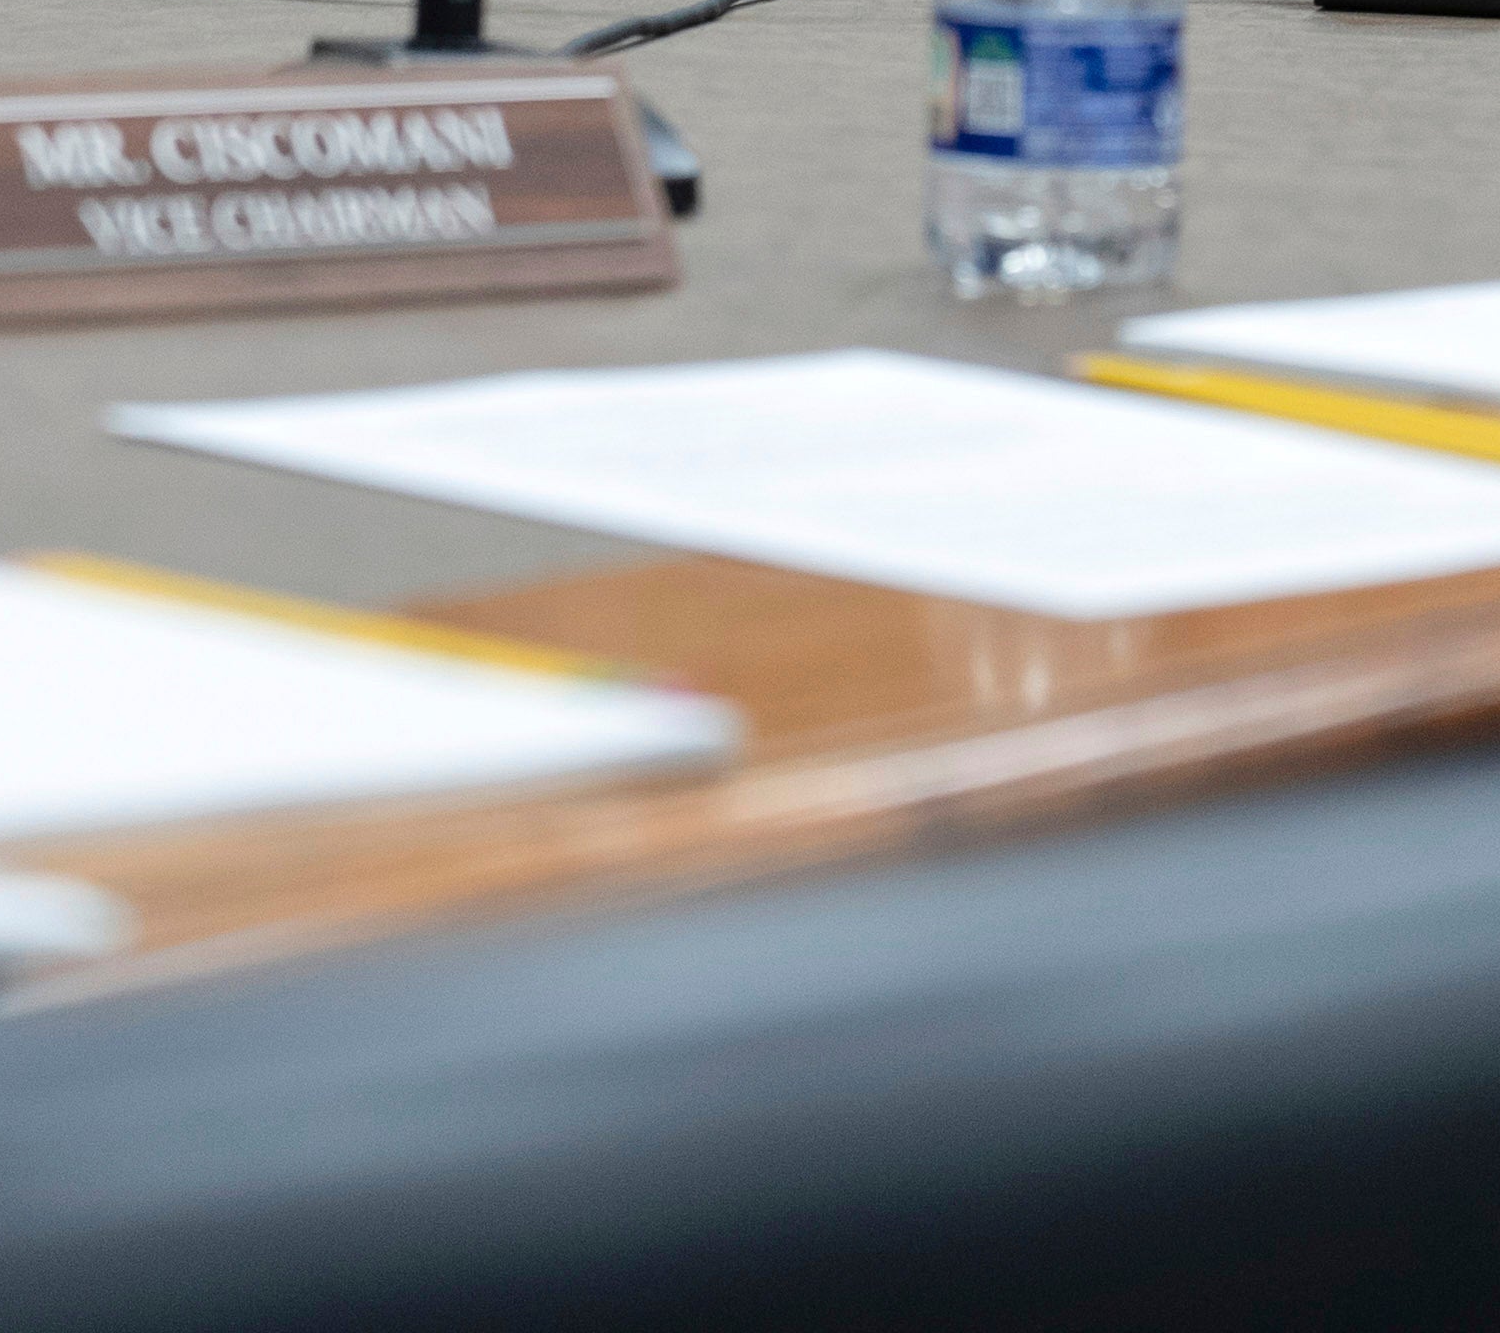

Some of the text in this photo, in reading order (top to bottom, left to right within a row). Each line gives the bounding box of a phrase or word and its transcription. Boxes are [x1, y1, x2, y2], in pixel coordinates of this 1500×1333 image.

[17, 104, 513, 191] MR. CISCOMANI
[78, 181, 498, 256] VICE CHAIRMAN
